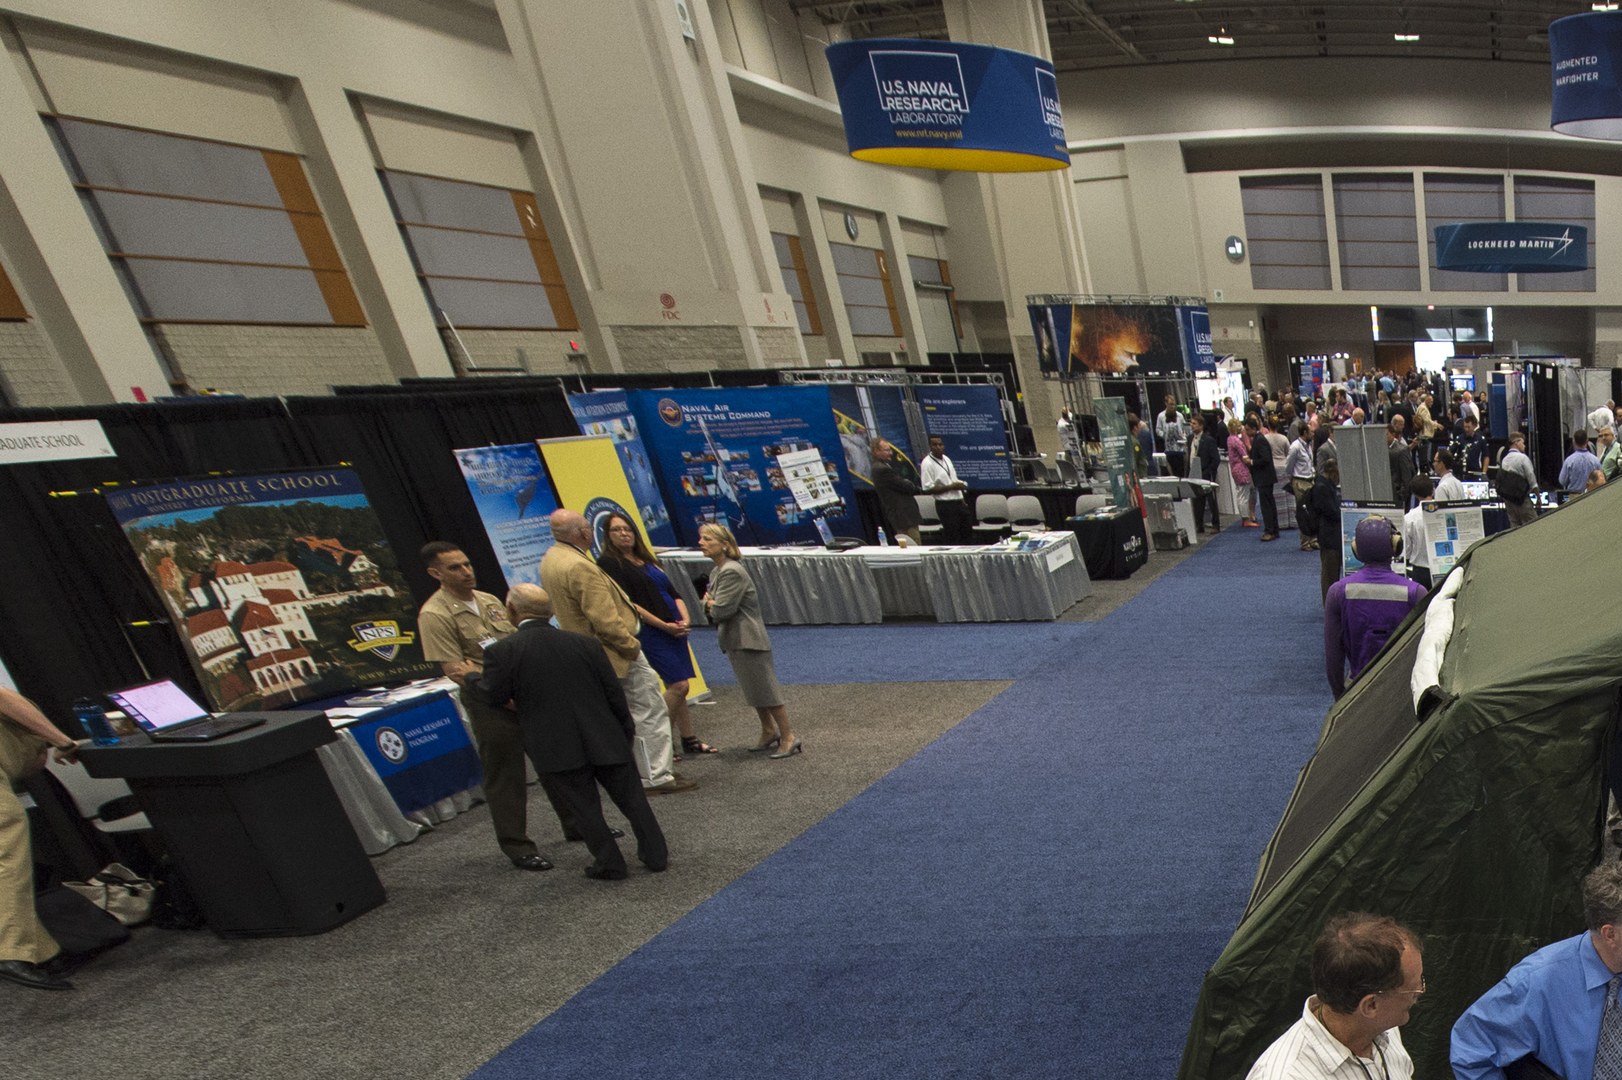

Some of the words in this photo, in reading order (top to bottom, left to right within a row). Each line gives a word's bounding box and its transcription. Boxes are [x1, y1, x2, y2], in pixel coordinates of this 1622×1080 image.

[1556, 56, 1598, 71] AUGMENTED
[1556, 72, 1599, 87] WARFIGHTER
[881, 80, 907, 95] U.S.
[908, 80, 959, 98] NAVAL
[886, 97, 961, 112] RESEARCH
[888, 112, 964, 126] LABORATORY
[896, 129, 964, 140] www.nrl.navy.mil
[1468, 240, 1516, 249] LOCKHEED
[1520, 240, 1555, 249] MARTIN
[682, 404, 711, 413] NAVAL
[714, 404, 730, 412] AIR
[684, 412, 727, 422] SYSTEMS
[728, 411, 771, 420] COMMAND
[0, 436, 43, 450] ADUATE
[42, 434, 85, 448] SCHOOL
[132, 480, 250, 507] POSTGRADUATE
[256, 474, 342, 492] SCHOOL
[363, 626, 395, 641] NPS
